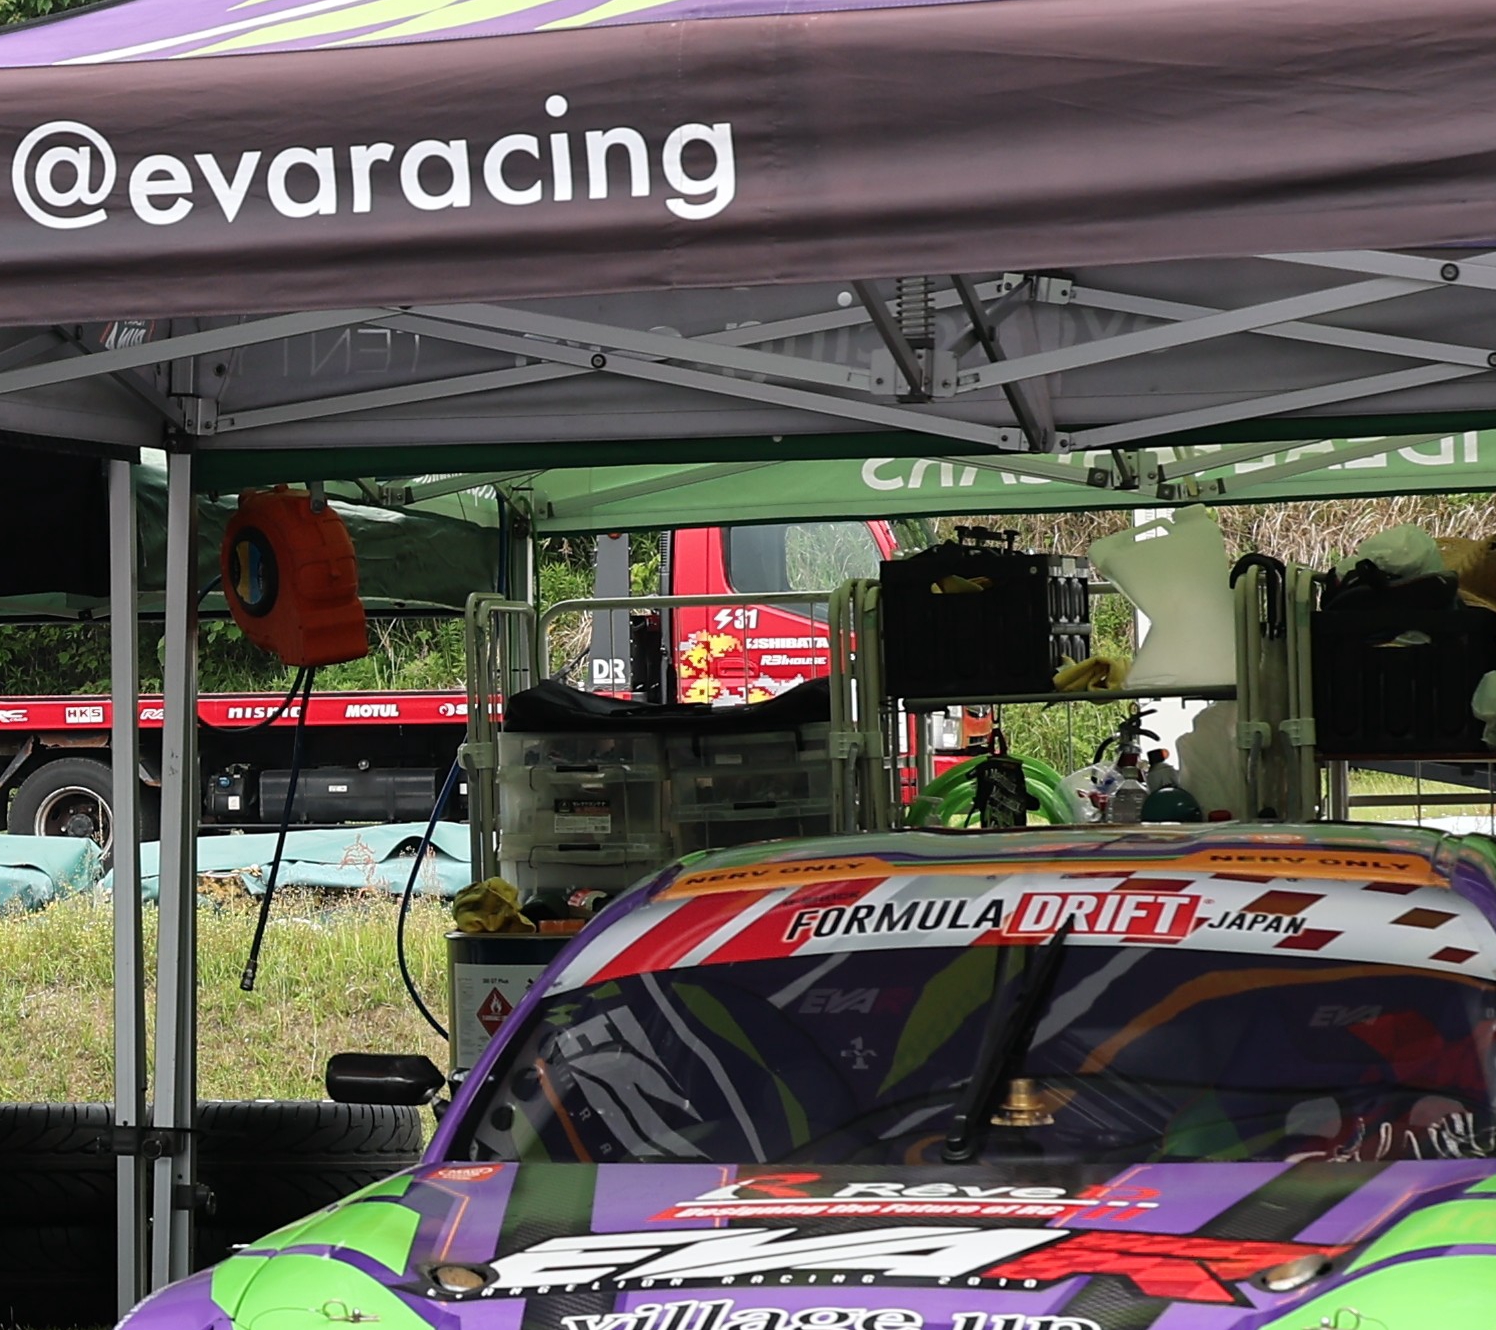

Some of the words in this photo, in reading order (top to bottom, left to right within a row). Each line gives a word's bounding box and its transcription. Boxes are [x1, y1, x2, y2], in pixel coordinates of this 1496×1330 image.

[11, 95, 738, 230] @evaracing
[757, 636, 829, 650] SHIBATA
[593, 658, 626, 679] DR
[65, 706, 104, 723] HKS
[344, 703, 400, 718] MOTUL
[1209, 852, 1297, 867] NERV
[1307, 855, 1411, 872] ONLY
[685, 868, 773, 887] NERV
[781, 860, 866, 878] ONLY
[783, 899, 1003, 942] FORMULA
[1009, 891, 1194, 938] DRIFT
[1207, 910, 1308, 936] JAPAN
[721, 1272, 878, 1286] RACING
[937, 1275, 1039, 1290] 2010
